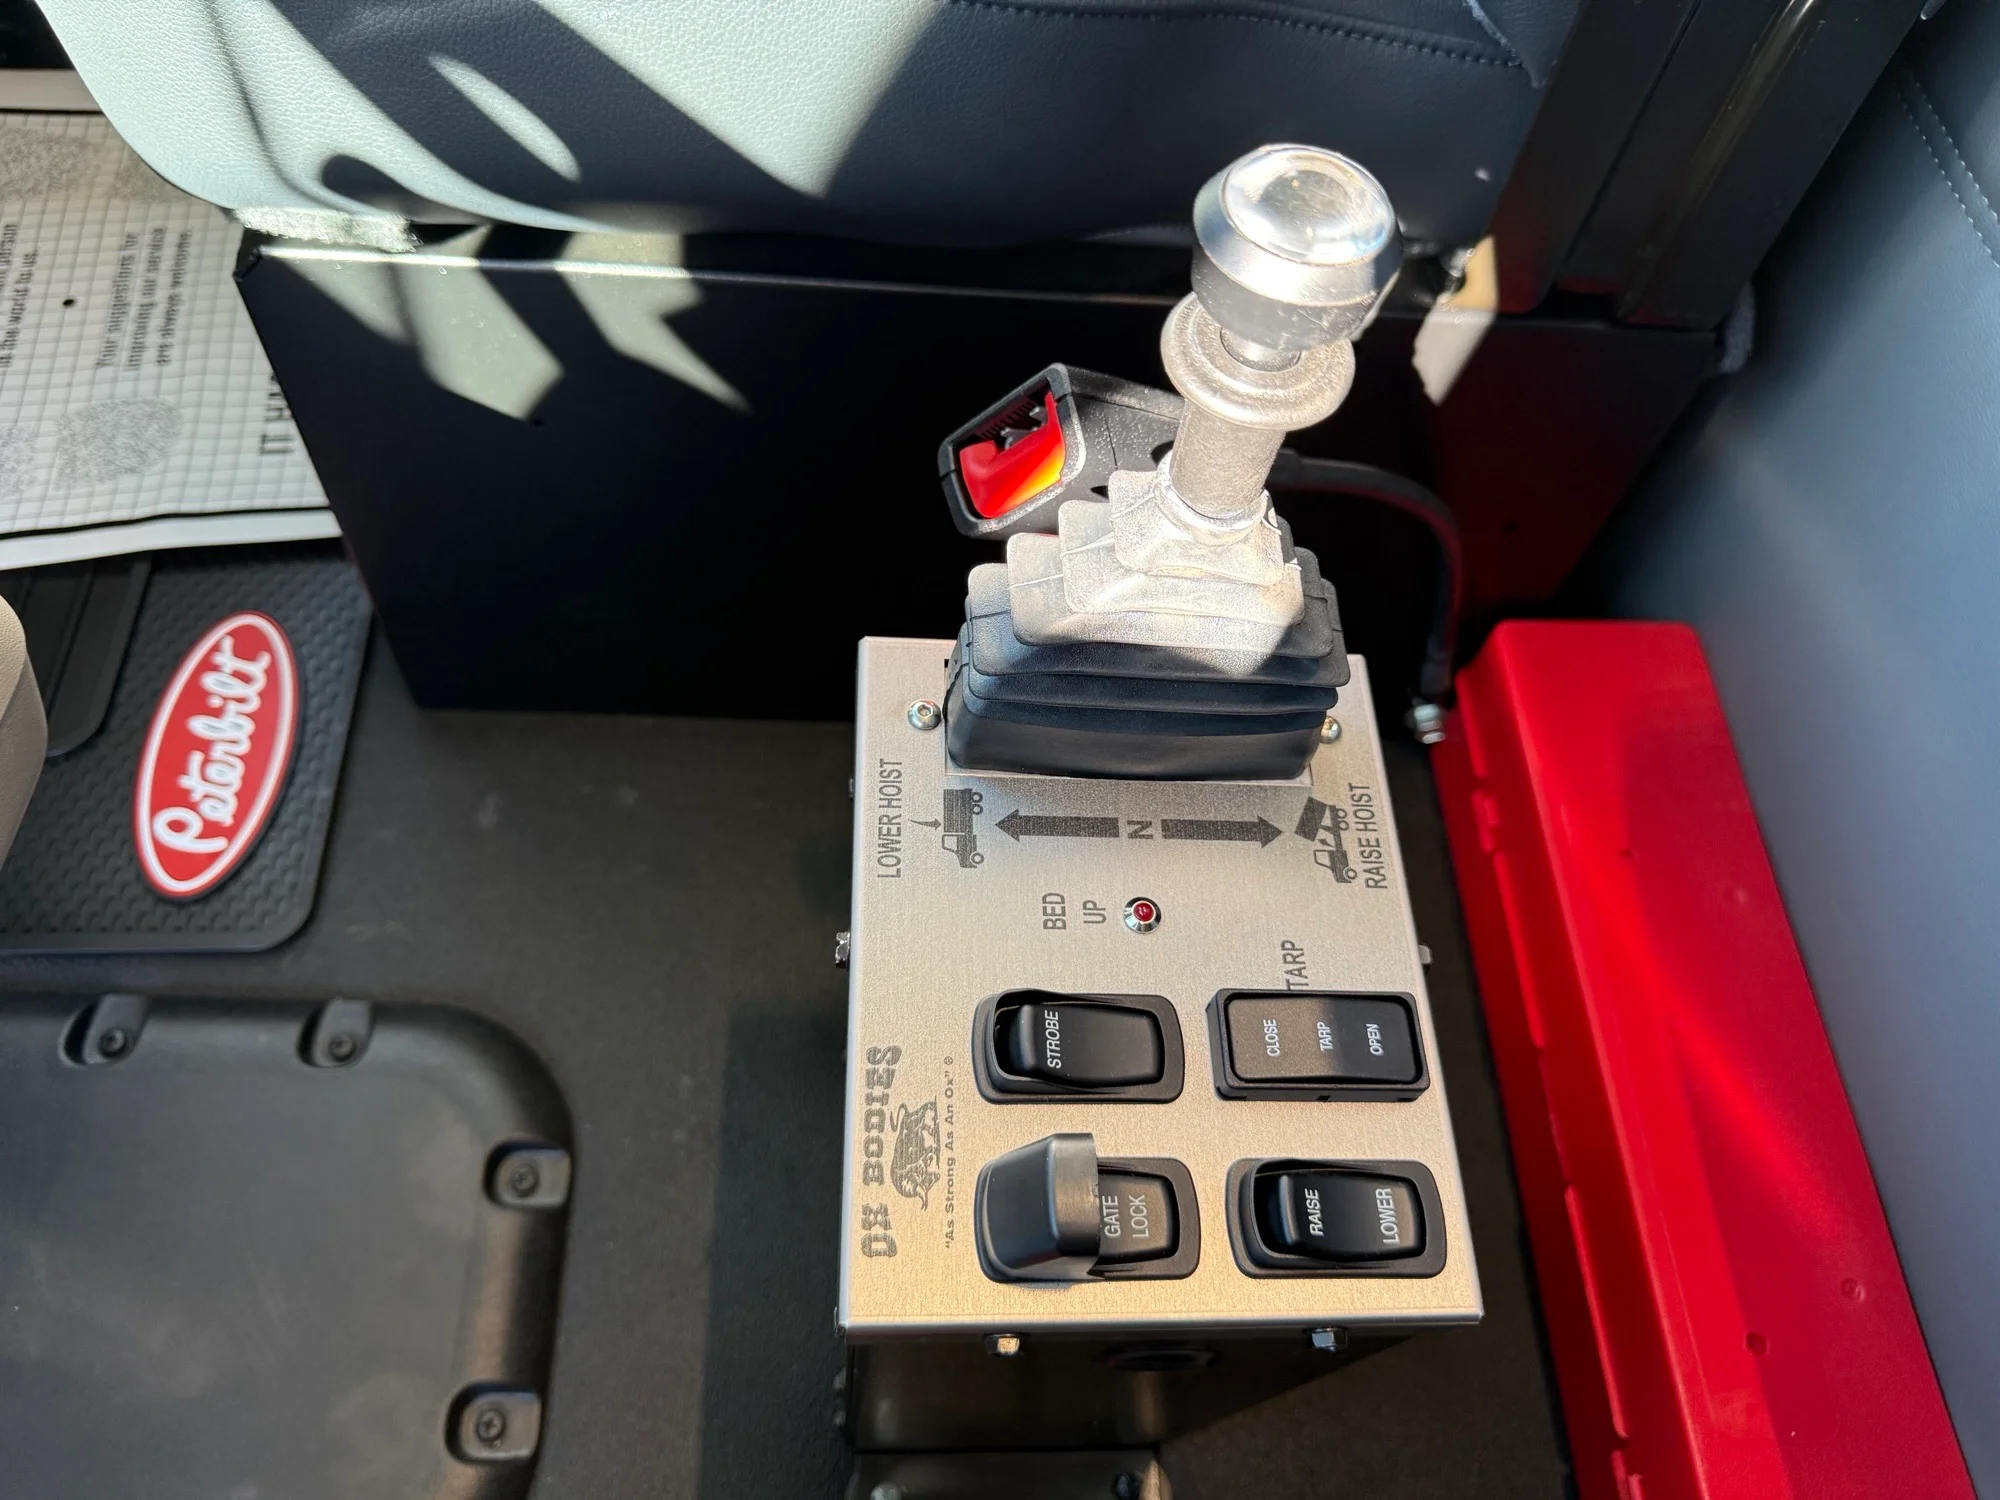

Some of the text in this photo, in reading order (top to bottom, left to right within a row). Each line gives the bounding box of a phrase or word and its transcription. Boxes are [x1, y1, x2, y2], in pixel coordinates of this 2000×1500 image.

[153, 634, 272, 854] Peterbilt
[878, 758, 903, 879] LOWER HOIST
[1126, 820, 1154, 841] N
[1347, 782, 1388, 890] RAISE HOIST
[1042, 892, 1067, 930] BED
[1082, 899, 1107, 924] UP
[1280, 939, 1310, 990] TARP
[1043, 1010, 1062, 1068] STROBE
[1262, 1019, 1281, 1057] CLOSE
[1316, 1021, 1335, 1052] TARP
[1365, 1023, 1383, 1056] OPEN
[944, 1104, 955, 1125] An
[861, 1045, 902, 1258] OX BODIES
[944, 1130, 955, 1151] As
[944, 1156, 957, 1214] Strong
[1101, 1195, 1121, 1238] GATE
[1128, 1195, 1150, 1238] LOCK
[1303, 1188, 1324, 1237] RAISE
[1374, 1188, 1401, 1244] LOWER
